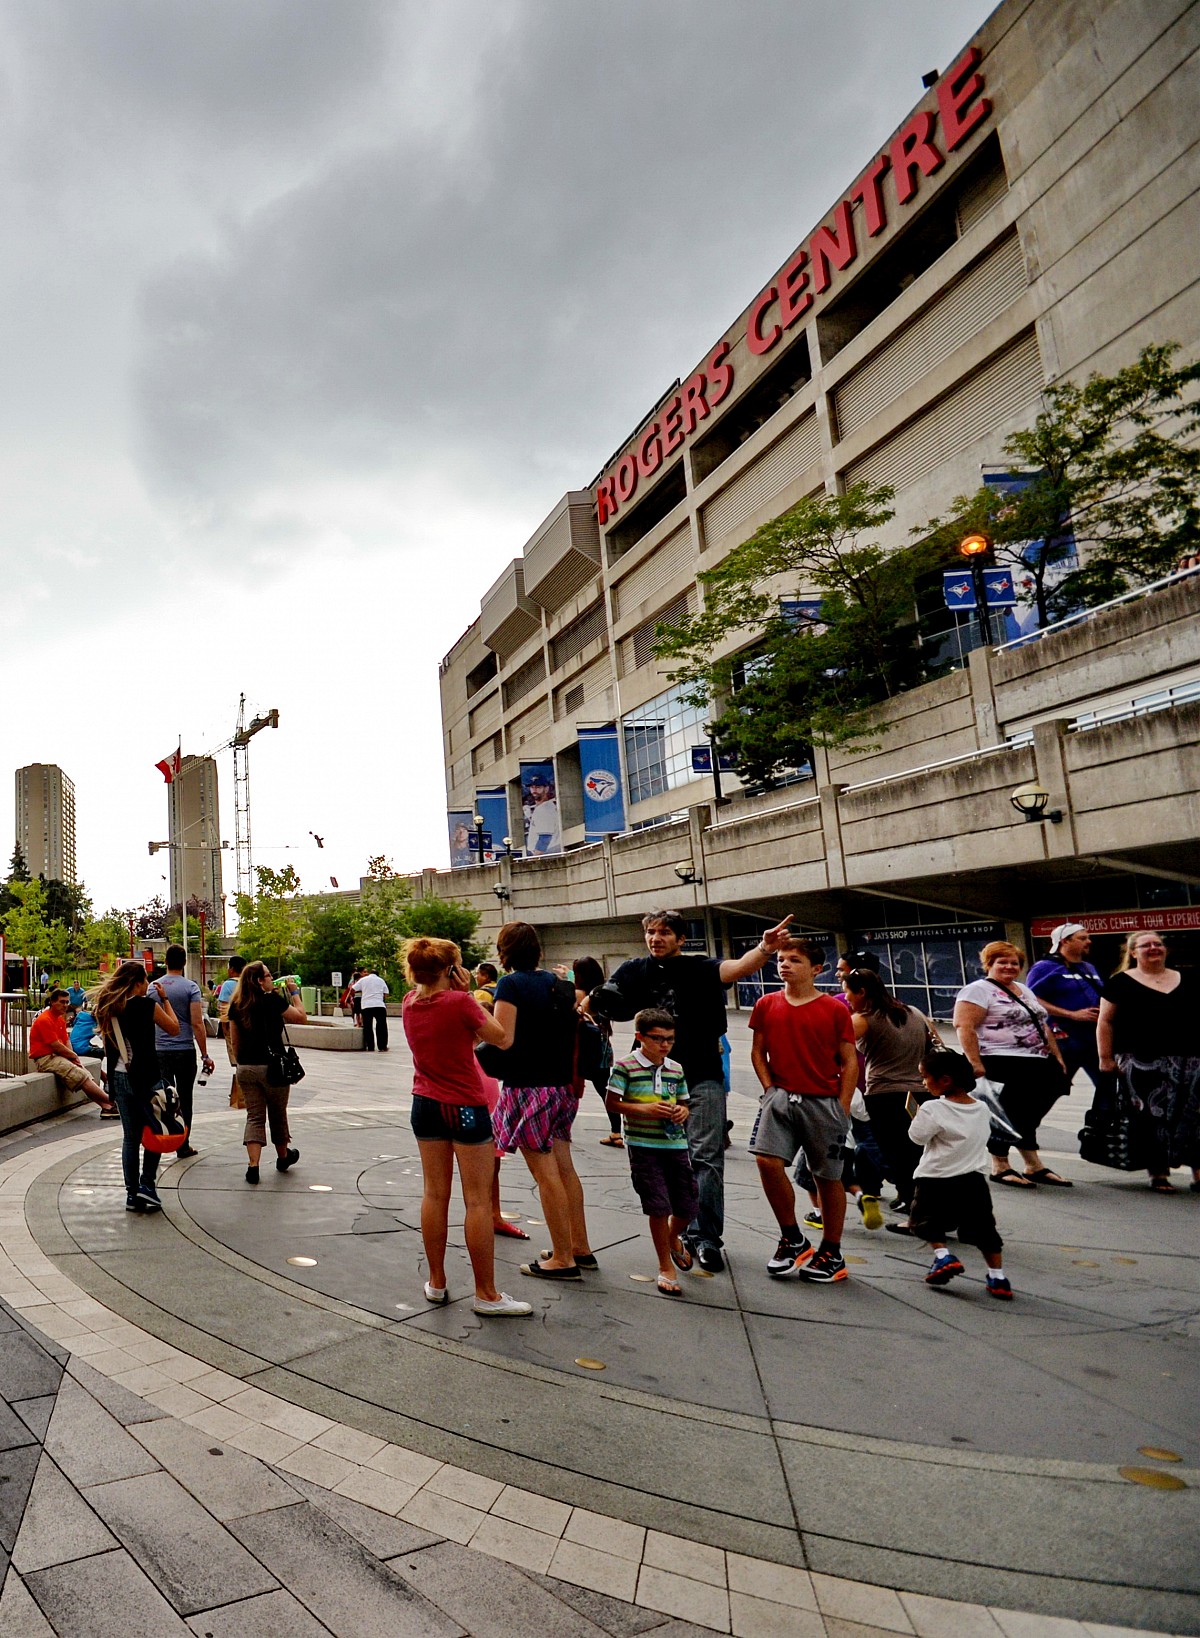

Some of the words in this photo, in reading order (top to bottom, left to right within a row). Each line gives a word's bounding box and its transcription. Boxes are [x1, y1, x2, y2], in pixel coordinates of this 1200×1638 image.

[598, 342, 734, 526] ROGERS
[747, 46, 993, 356] CENTRE
[1078, 918, 1109, 931] ROGERS
[1110, 916, 1140, 930] CENTRE
[1143, 914, 1164, 928] TOUR
[874, 931, 889, 940] JAYS
[890, 930, 908, 939] SHOP
[910, 929, 944, 937] OFFICIAL
[948, 927, 968, 935] TEAM
[973, 925, 994, 933] SHOP
